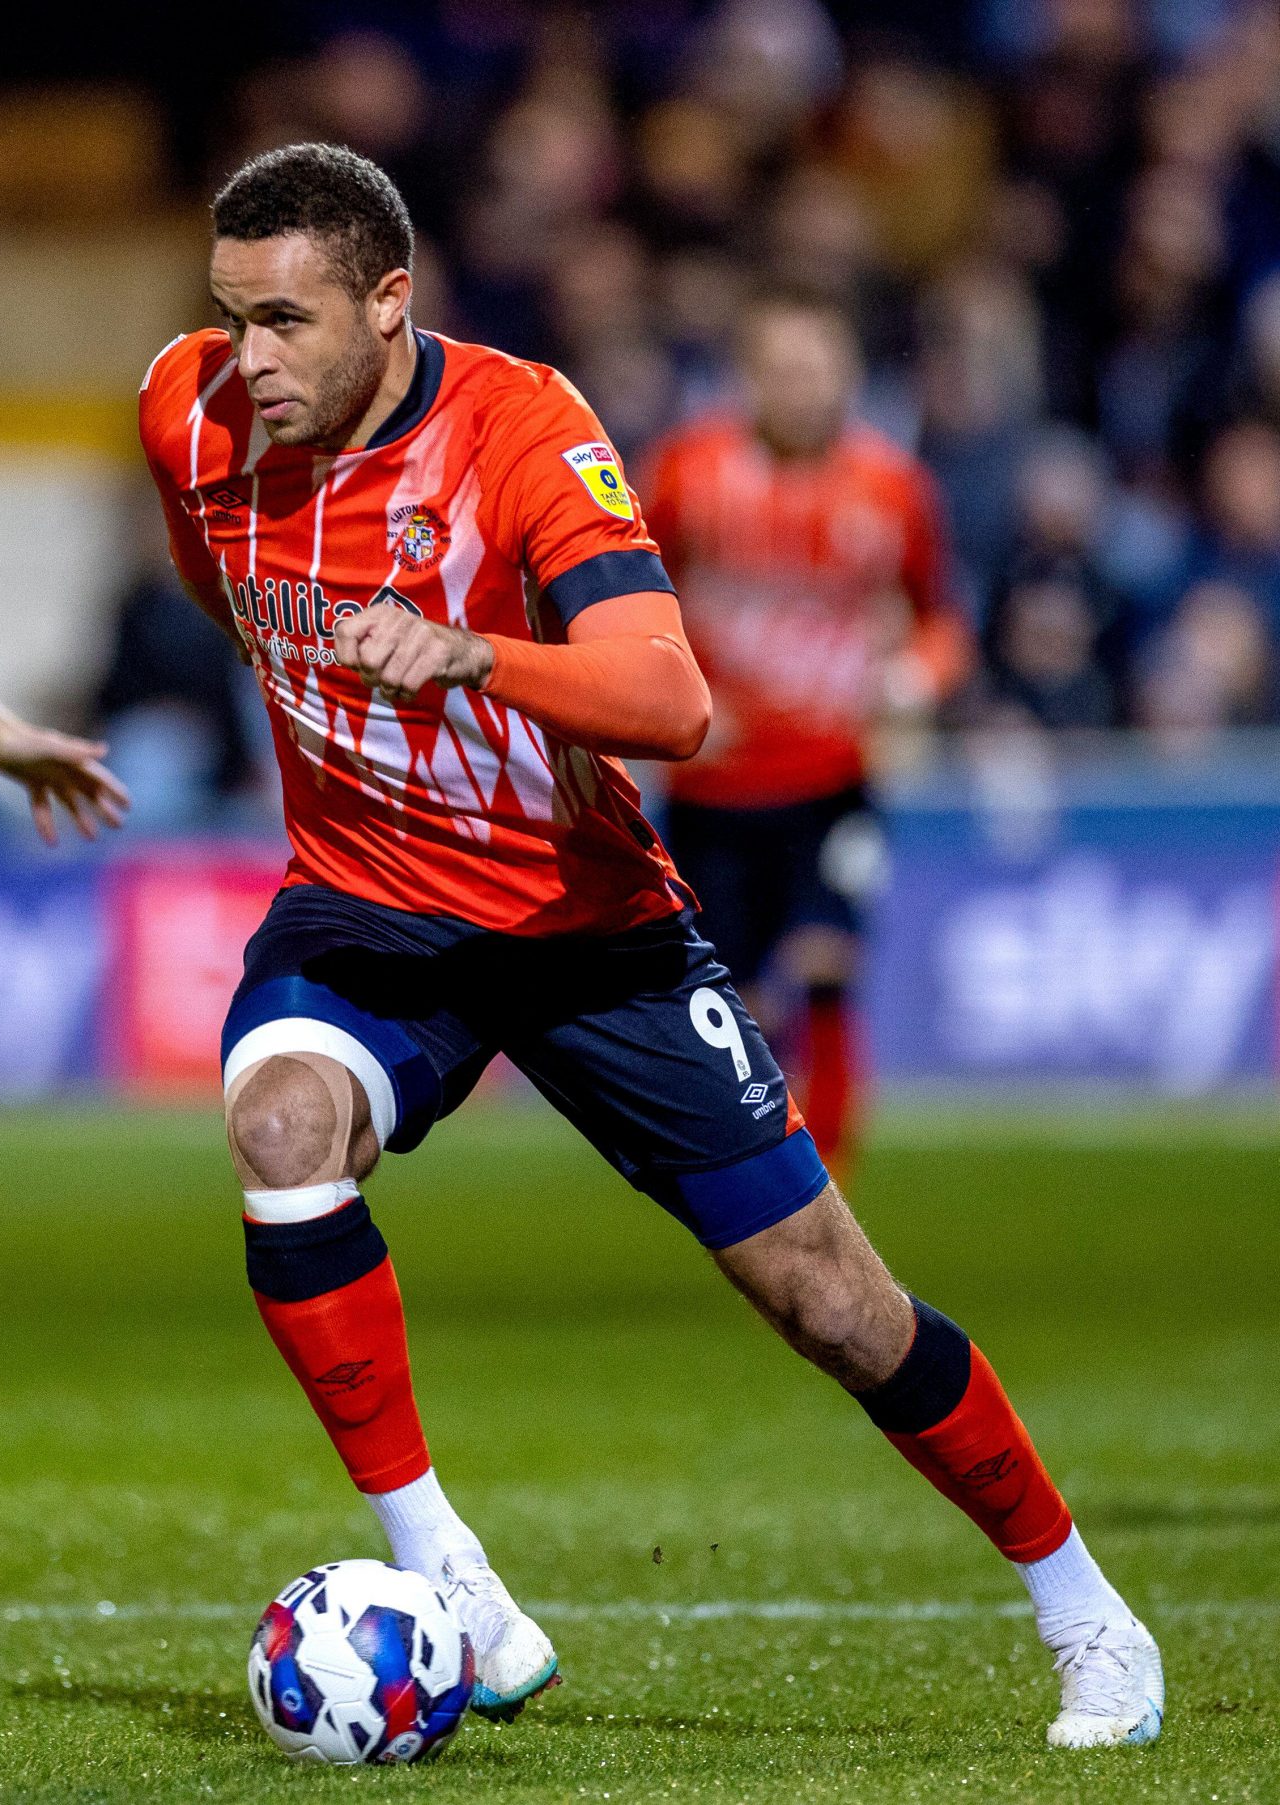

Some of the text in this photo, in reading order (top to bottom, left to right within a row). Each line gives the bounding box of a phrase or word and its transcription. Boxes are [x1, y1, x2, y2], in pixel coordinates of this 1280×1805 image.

[572, 449, 611, 464] sky bet
[600, 491, 619, 501] TAKE
[390, 504, 419, 523] LUTON
[689, 987, 751, 1082] 9
[752, 1100, 776, 1120] umbro
